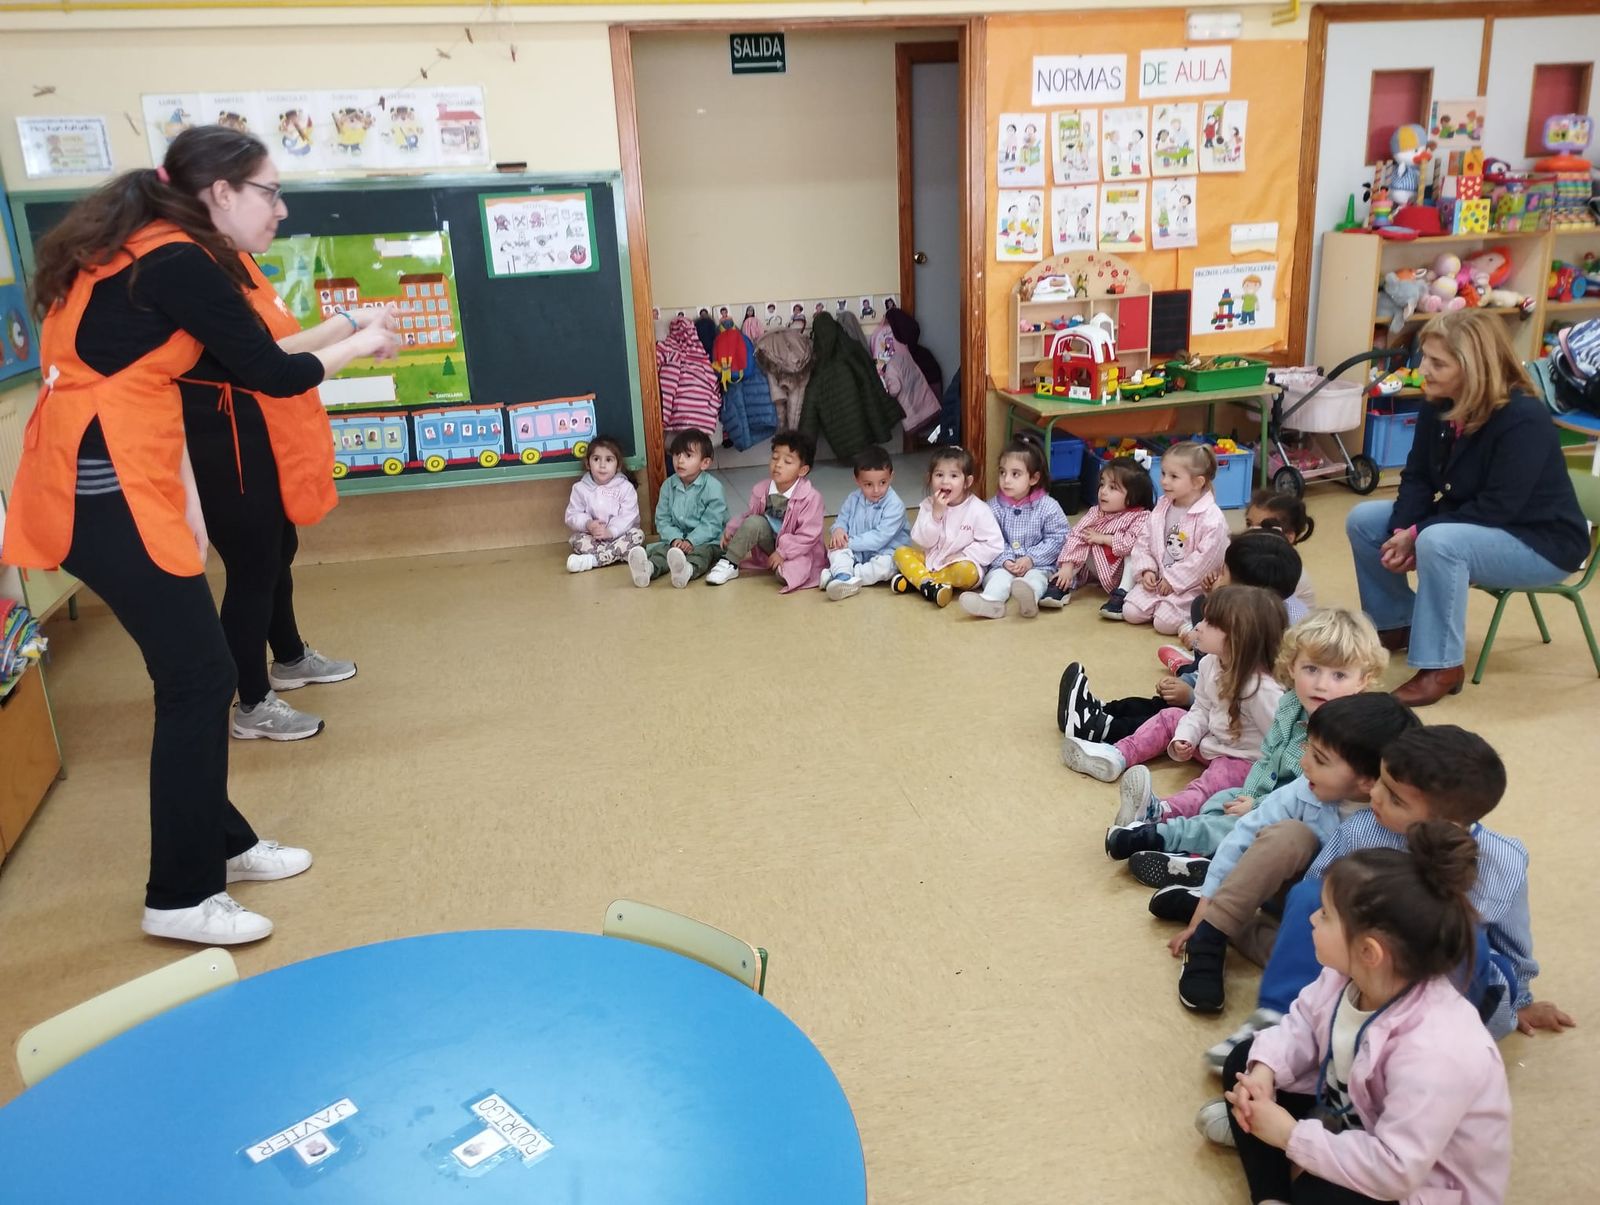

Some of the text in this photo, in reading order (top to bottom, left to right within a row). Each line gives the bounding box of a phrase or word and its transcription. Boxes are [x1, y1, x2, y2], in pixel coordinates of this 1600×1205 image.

[733, 36, 783, 58] SALIDA
[1037, 58, 1228, 93] NORMAS DE AULA
[257, 1103, 348, 1156] JAVIER
[478, 1098, 541, 1155] RODRIGO
